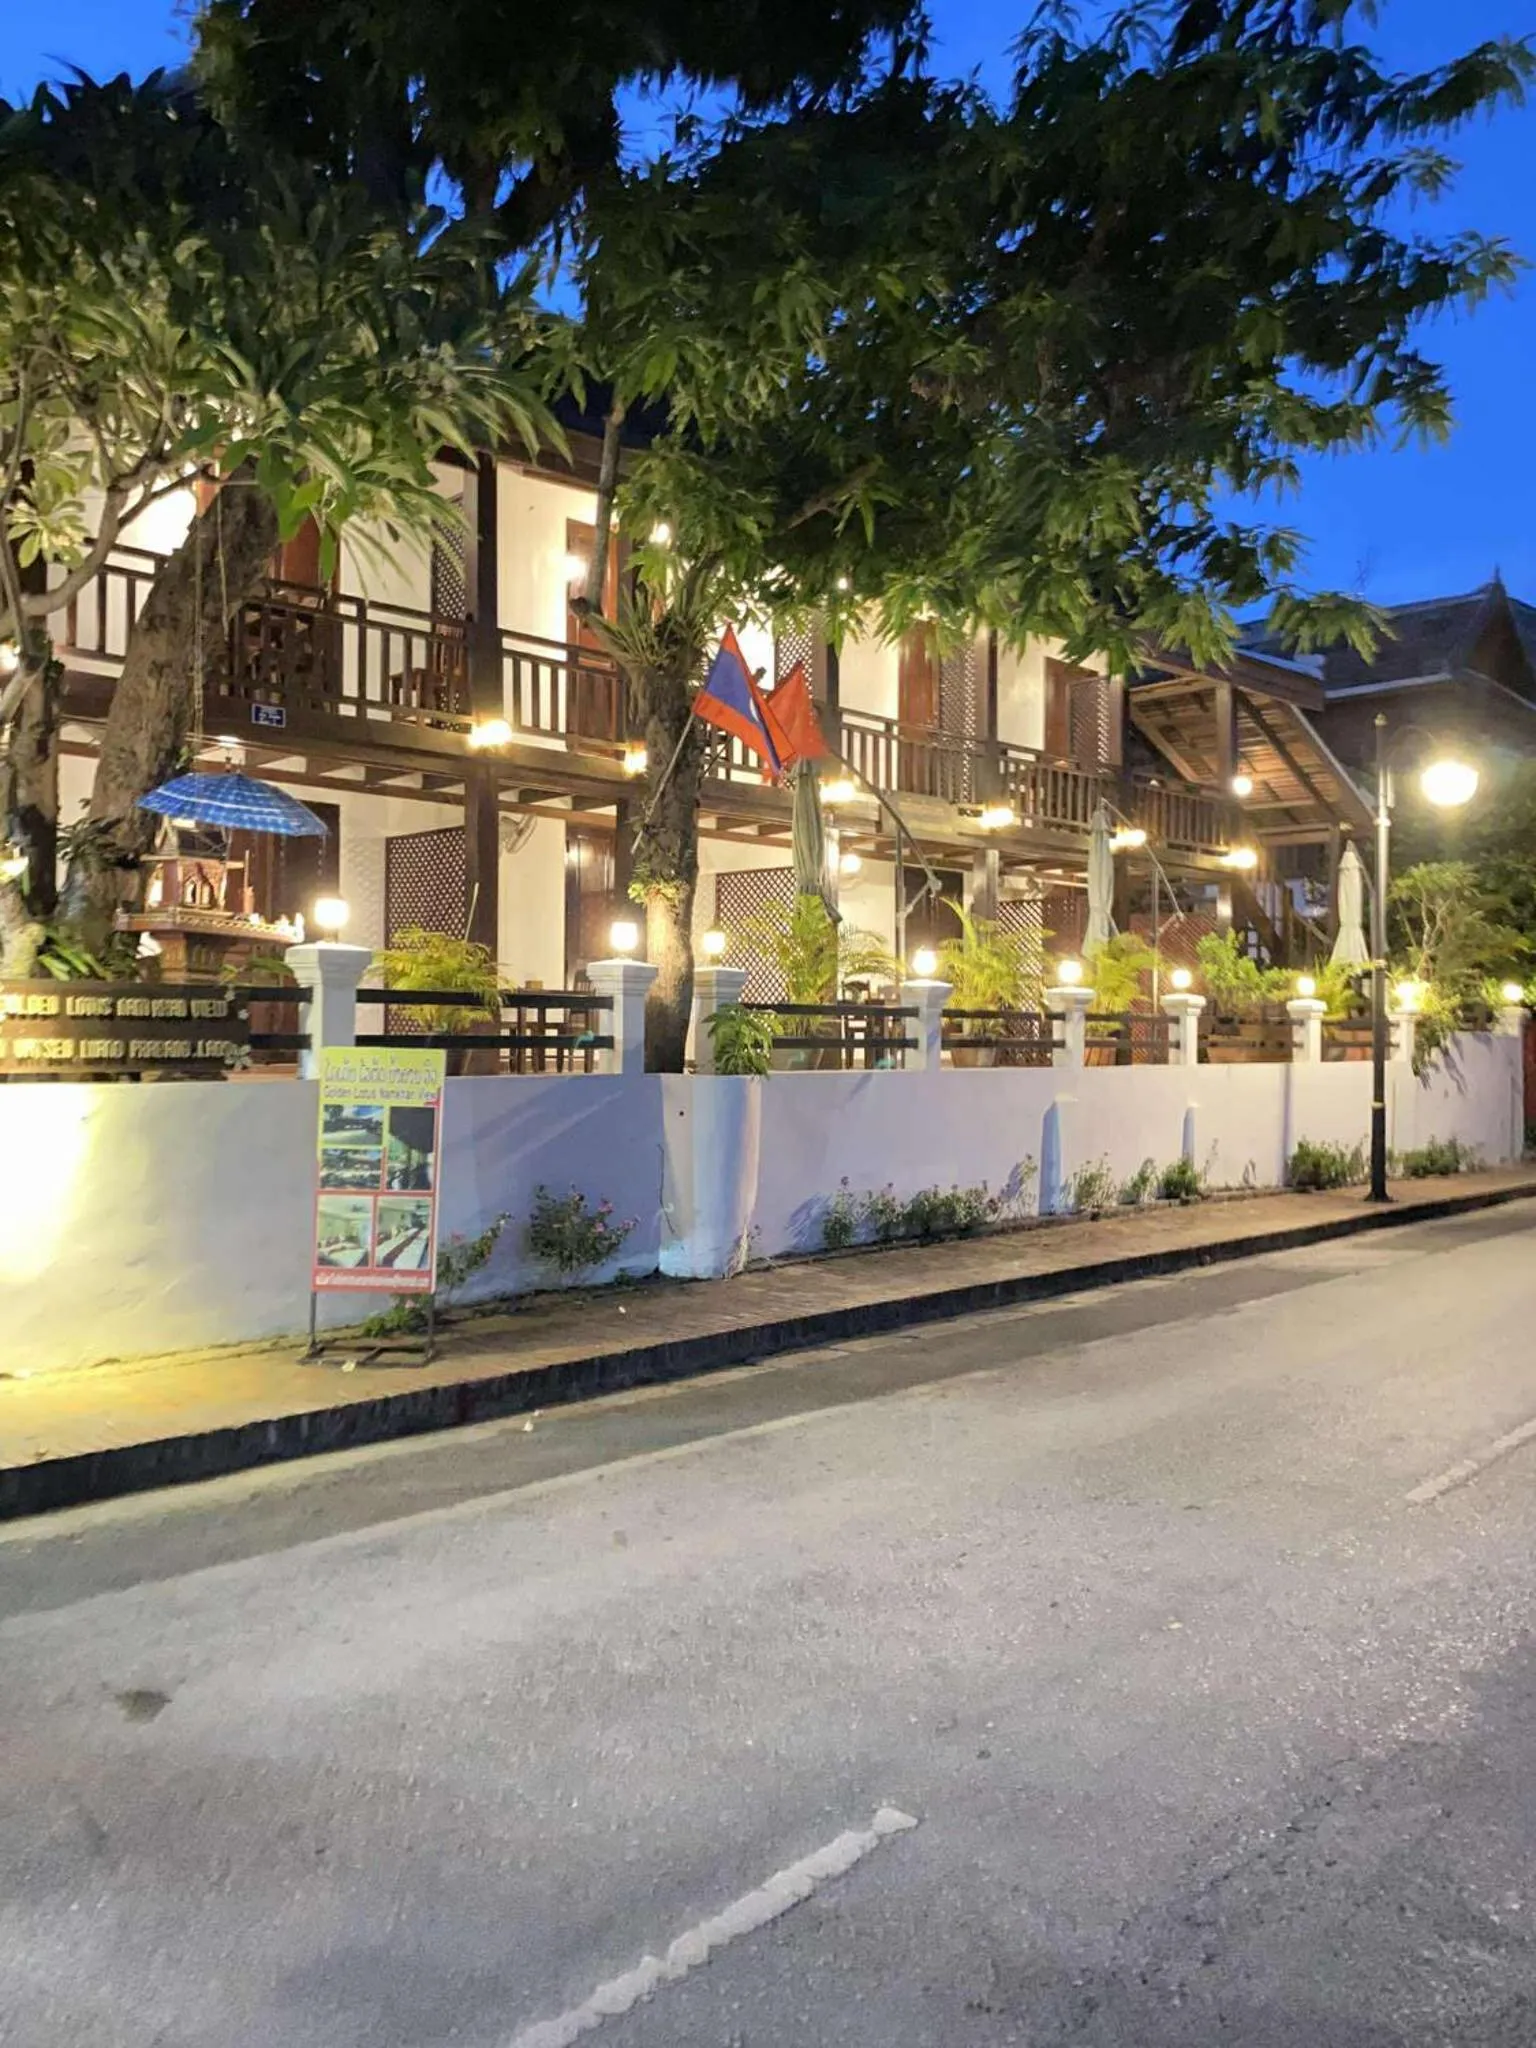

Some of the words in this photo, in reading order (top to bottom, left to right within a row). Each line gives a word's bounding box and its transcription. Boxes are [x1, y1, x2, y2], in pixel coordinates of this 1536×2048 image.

[65, 995, 113, 1016] LOTUS
[190, 999, 228, 1018] VIEW
[79, 1038, 125, 1059] LUANG
